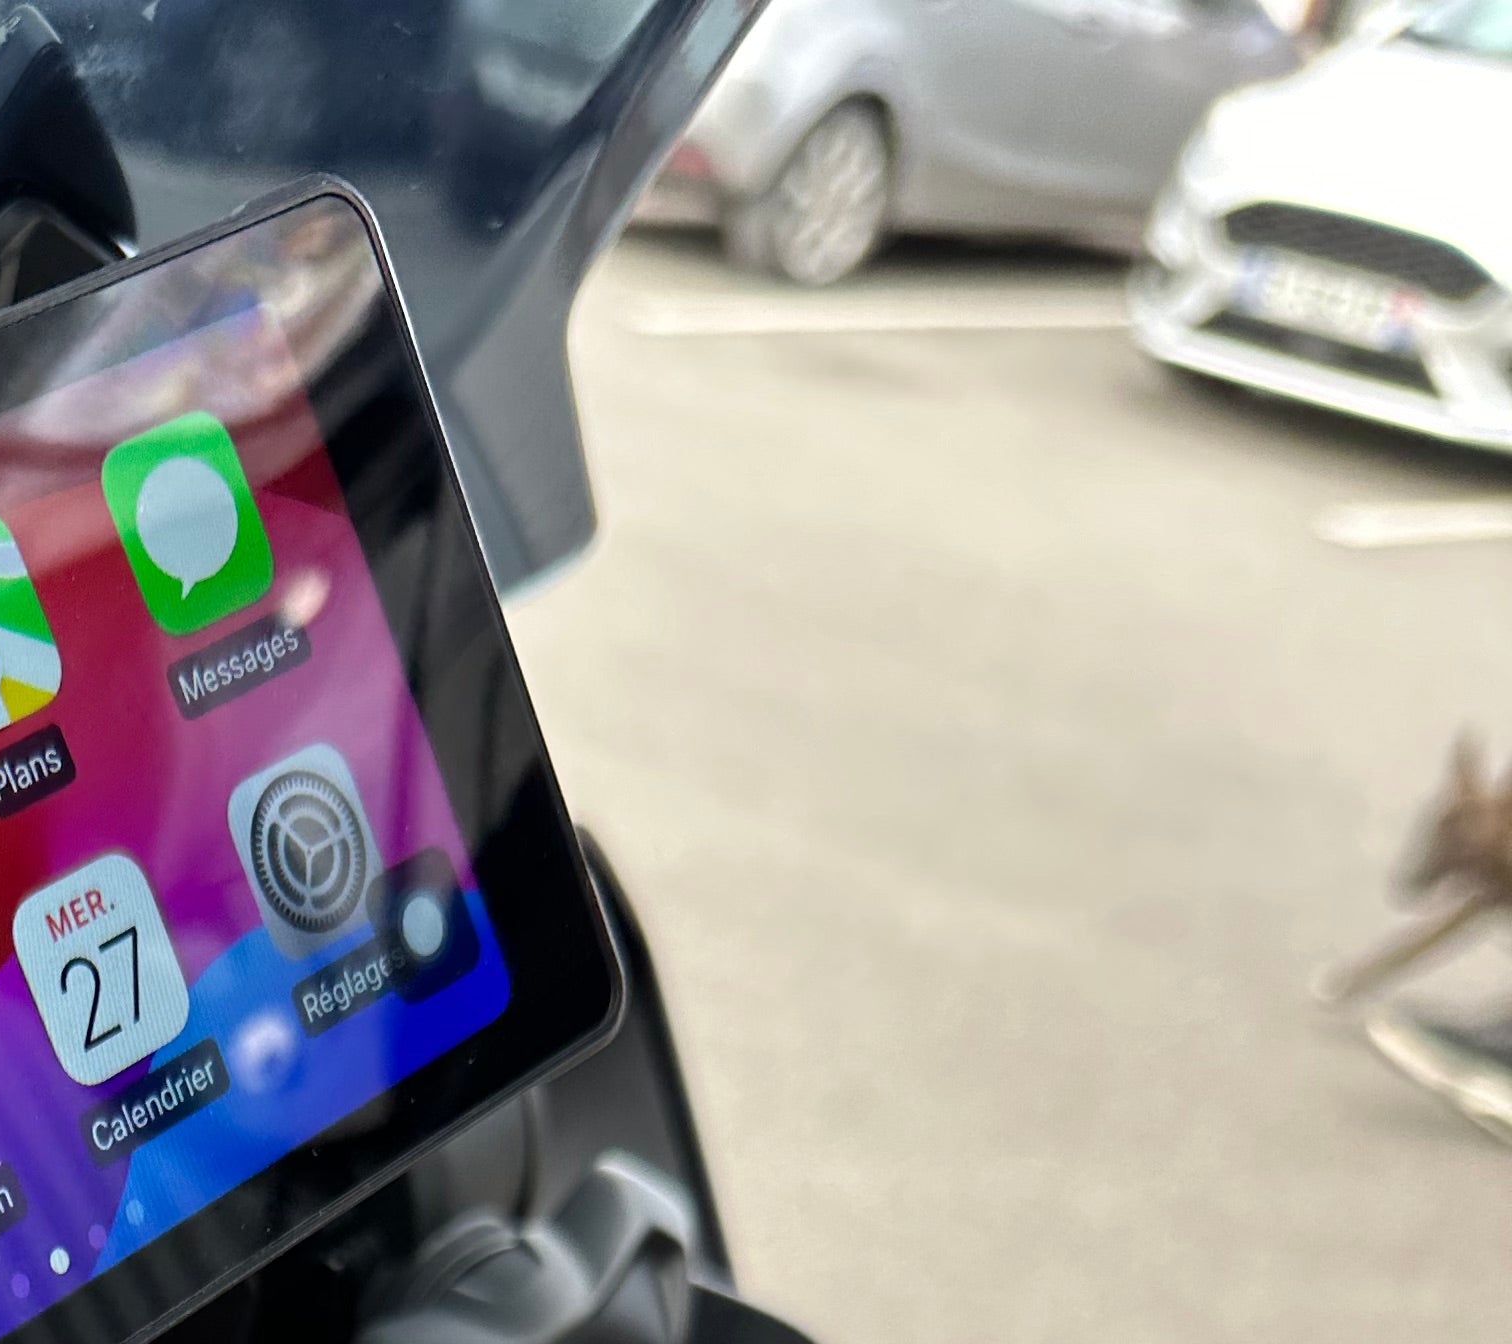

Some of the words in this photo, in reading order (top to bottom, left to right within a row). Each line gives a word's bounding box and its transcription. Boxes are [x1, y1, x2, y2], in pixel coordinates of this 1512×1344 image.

[178, 626, 299, 704] Messages
[44, 888, 117, 942] MER.
[58, 926, 141, 1053] 27
[91, 1054, 219, 1153] Calendrier
